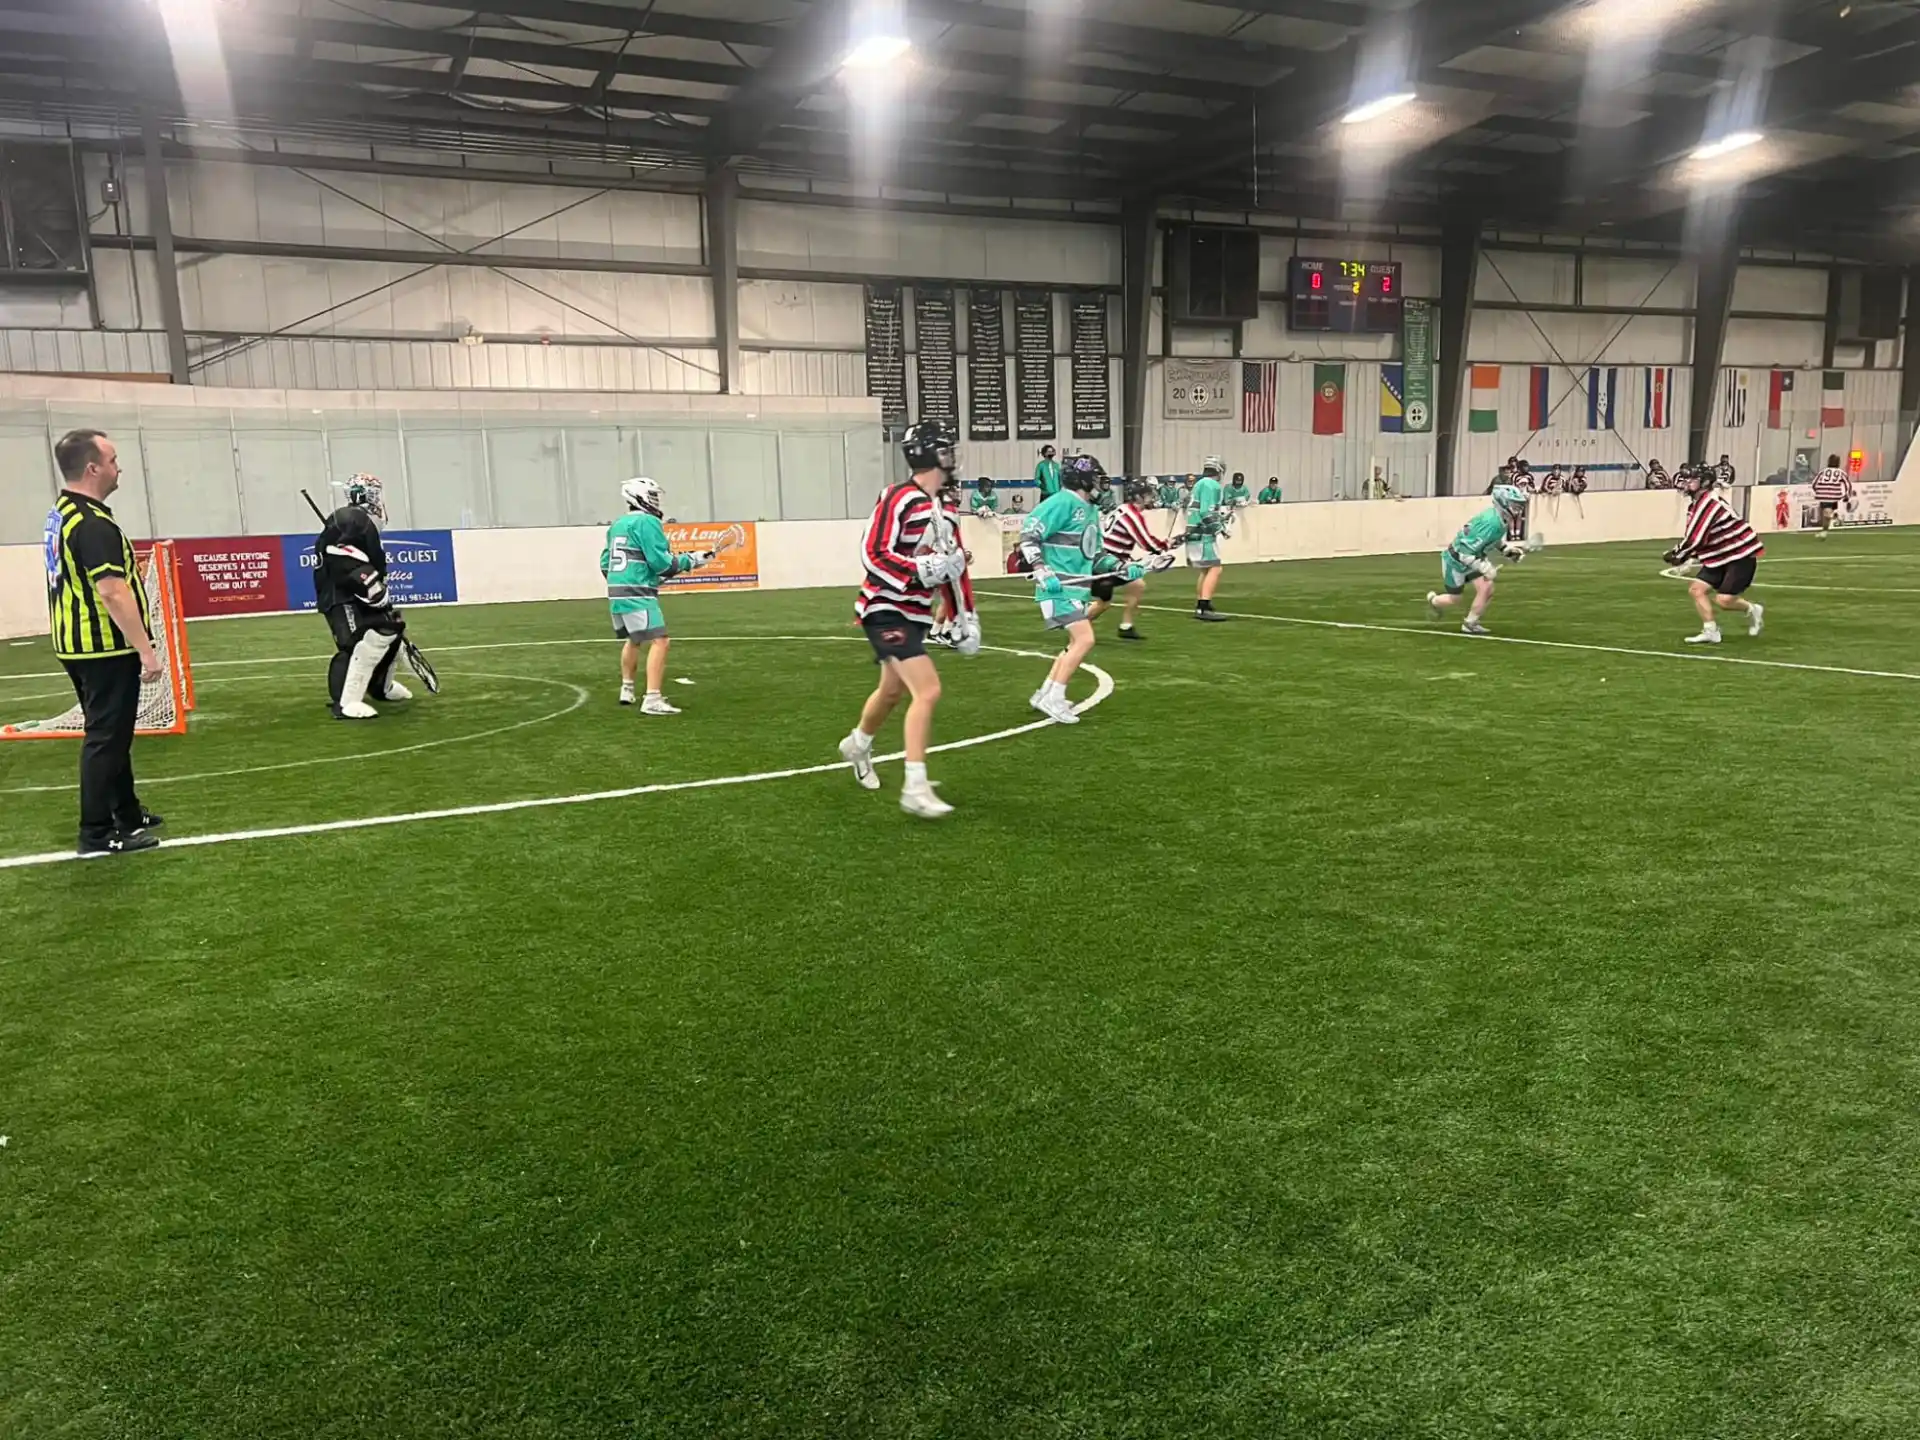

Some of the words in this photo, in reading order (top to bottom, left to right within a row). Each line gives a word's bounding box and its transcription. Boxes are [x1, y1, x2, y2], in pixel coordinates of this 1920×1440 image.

[1301, 262, 1324, 271] HOME
[1383, 277, 1392, 292] 2
[1172, 387, 1186, 399] 20
[1537, 439, 1596, 447] VISITOR
[1824, 469, 1841, 482] 99
[193, 553, 229, 563] BECAUSE
[230, 552, 271, 561] EVERYONE
[385, 551, 394, 564] &
[397, 549, 439, 563] GUEST
[609, 536, 627, 572] 5
[198, 562, 238, 572] DESERVES
[240, 562, 246, 570] A
[248, 561, 268, 569] CLUB
[201, 572, 221, 581] THEY
[223, 571, 240, 580] WILL
[242, 570, 268, 579] NEVER
[210, 582, 230, 590] GROW
[232, 581, 247, 589] OUT
